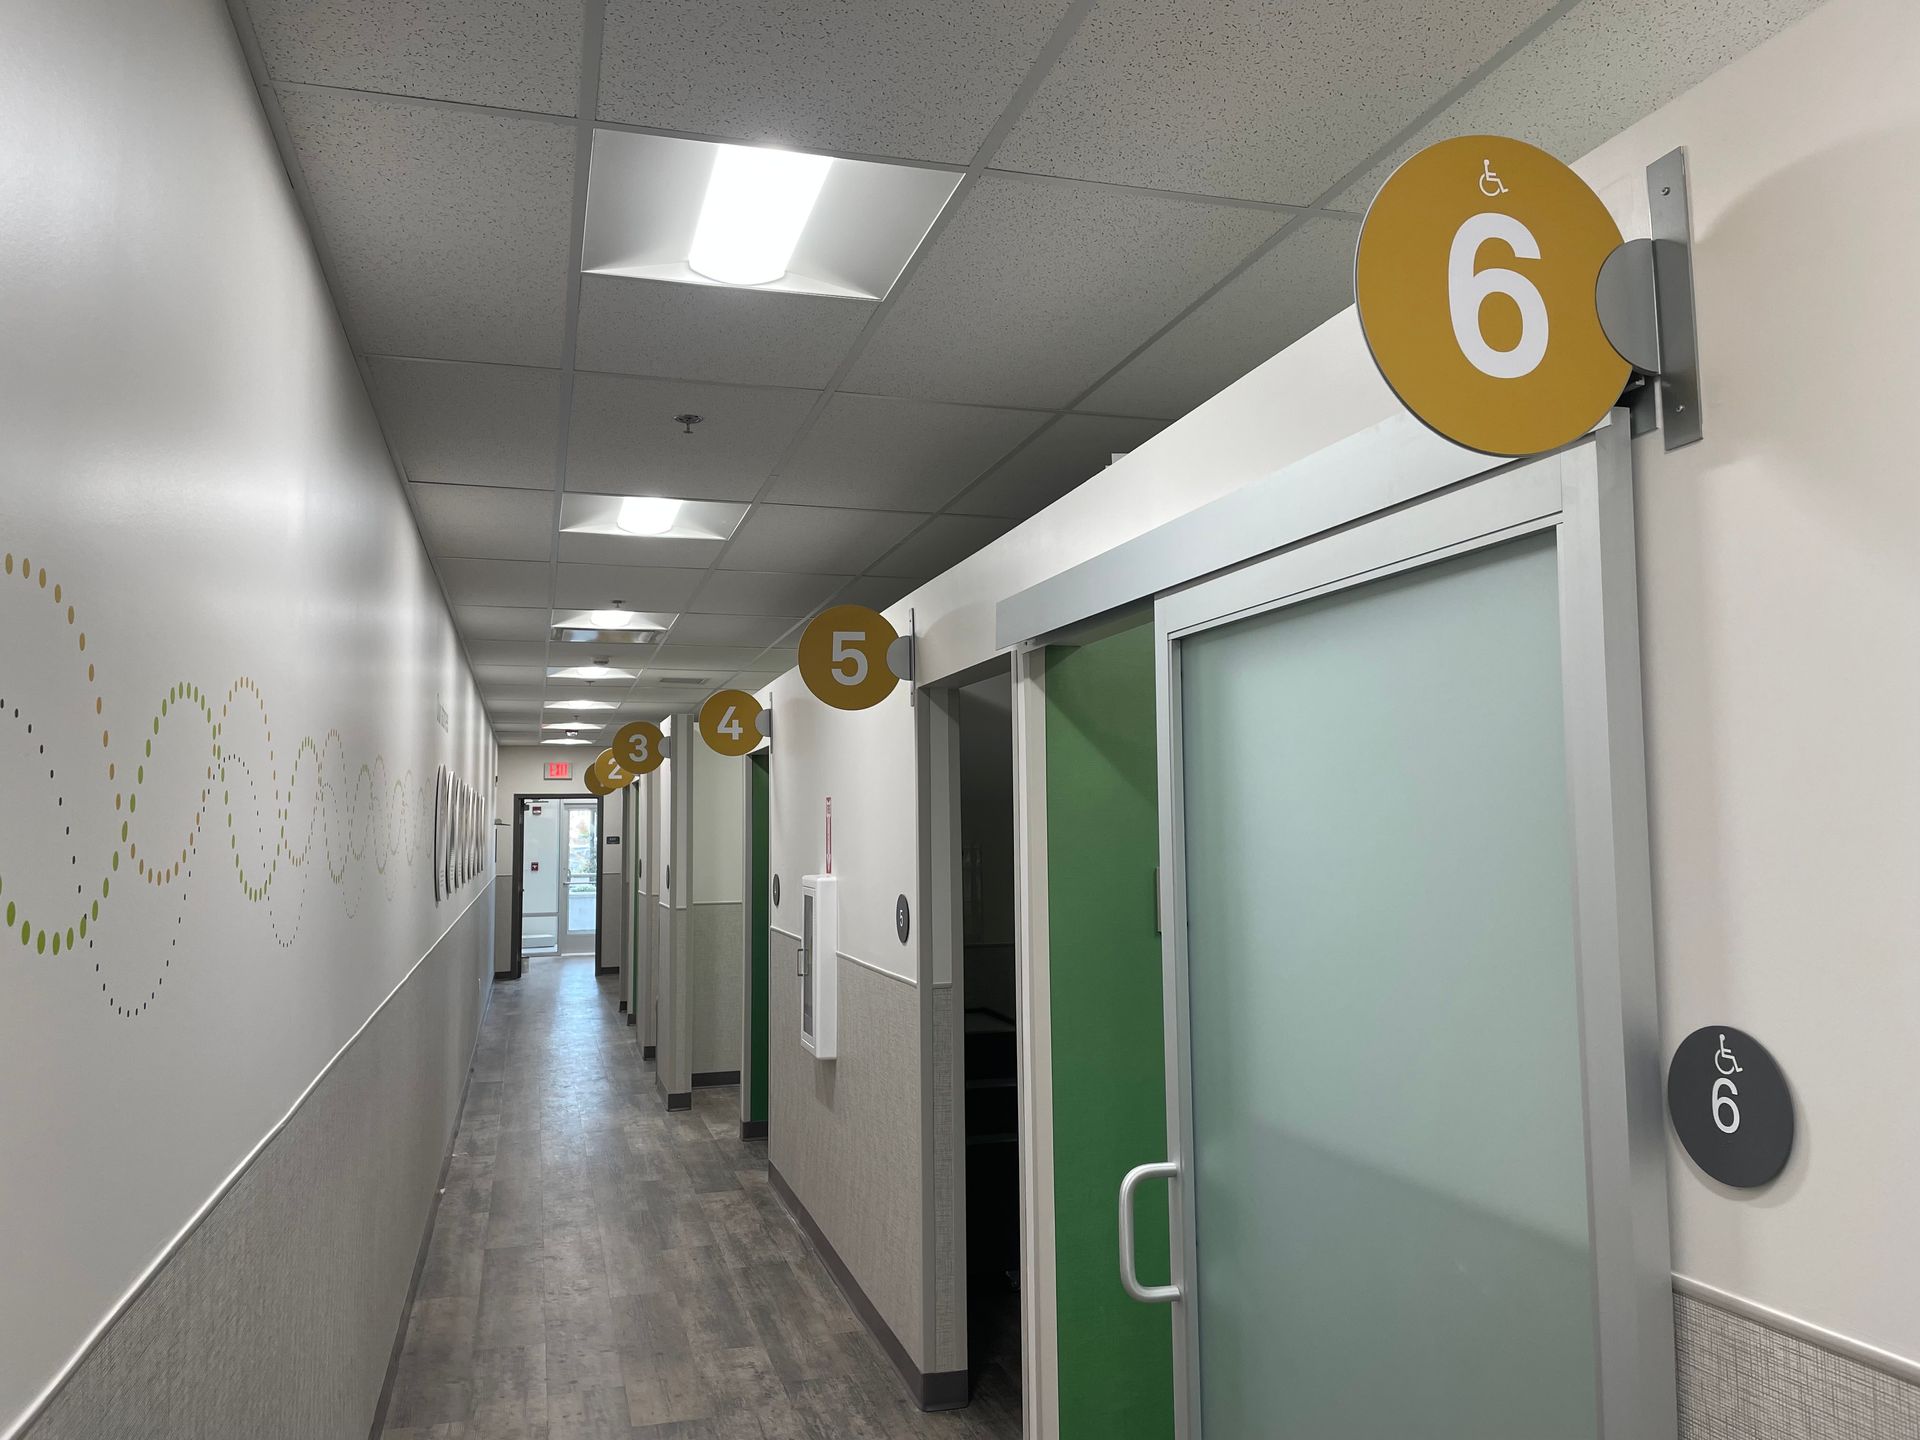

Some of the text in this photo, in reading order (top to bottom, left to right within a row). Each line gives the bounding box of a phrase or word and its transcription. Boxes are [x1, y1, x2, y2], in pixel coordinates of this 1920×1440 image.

[1448, 212, 1549, 379] 6
[832, 631, 868, 686] 5
[717, 706, 743, 740] 4
[628, 734, 648, 762] 3
[549, 762, 568, 777] EXIT
[608, 758, 622, 779] 2
[1711, 1077, 1740, 1133] 6
